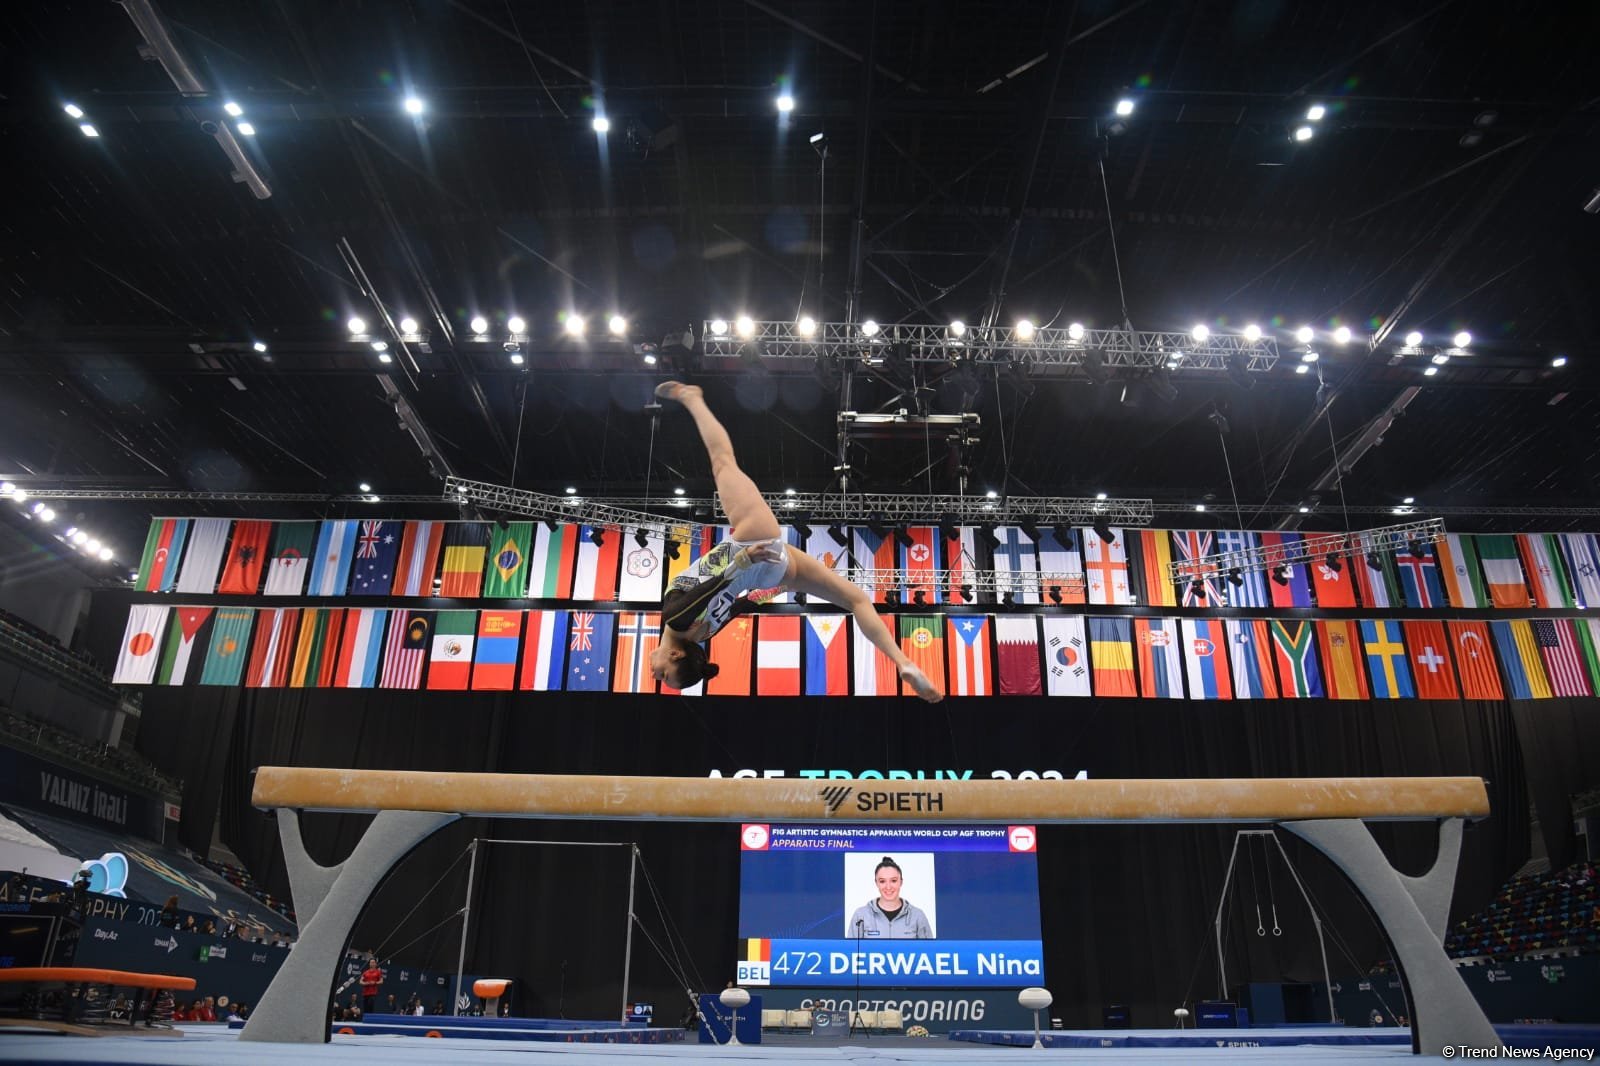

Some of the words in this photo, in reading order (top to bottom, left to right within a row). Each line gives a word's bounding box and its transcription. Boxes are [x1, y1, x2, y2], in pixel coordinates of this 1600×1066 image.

[857, 791, 943, 812] SPIETH
[772, 828, 785, 836] FIG
[869, 829, 912, 837] APPARATUS
[772, 839, 826, 848] APPARATUS
[828, 839, 854, 849] FINAL
[773, 952, 822, 975] 472
[830, 952, 969, 975] DERWAEL
[977, 952, 1040, 975] Nina
[738, 967, 769, 980] BEL
